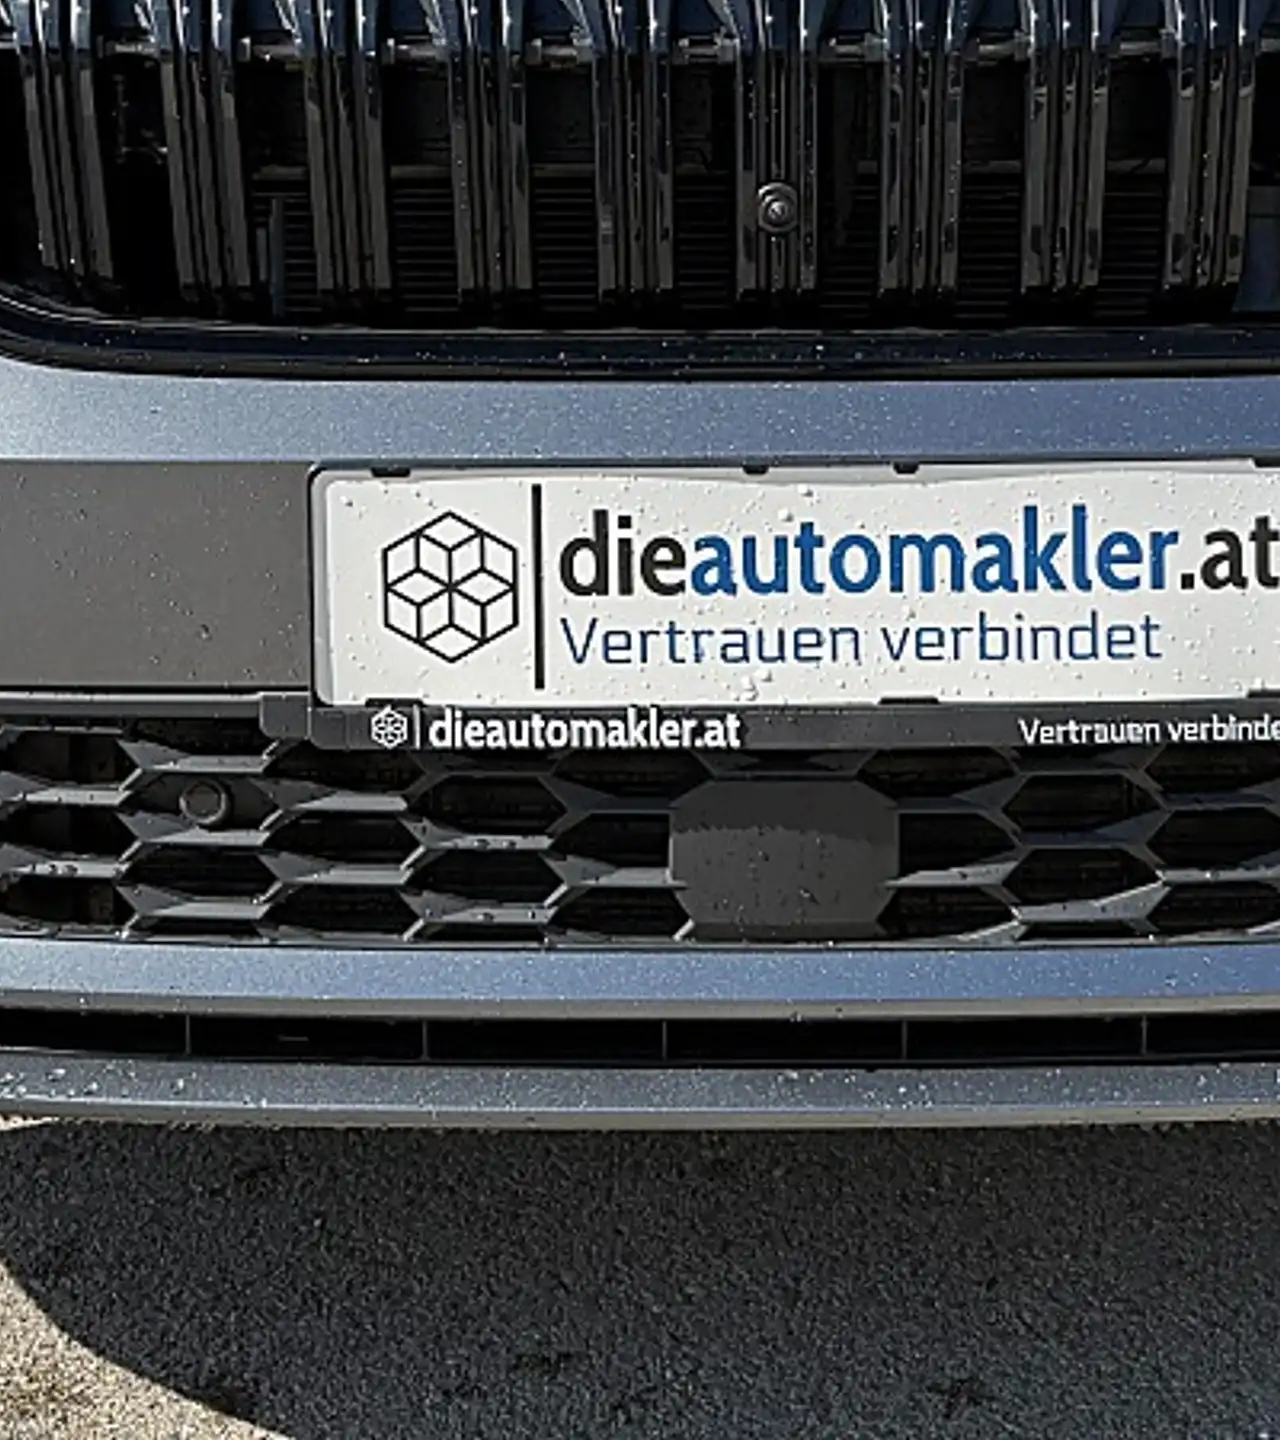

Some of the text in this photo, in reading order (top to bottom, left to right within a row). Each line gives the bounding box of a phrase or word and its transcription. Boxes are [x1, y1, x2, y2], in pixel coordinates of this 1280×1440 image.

[559, 503, 1280, 598] dieautomakler.at
[559, 609, 1163, 665] Vertrauen verbindet
[428, 707, 741, 750] dieautomakler.at
[1017, 718, 1161, 745] Vertrauen
